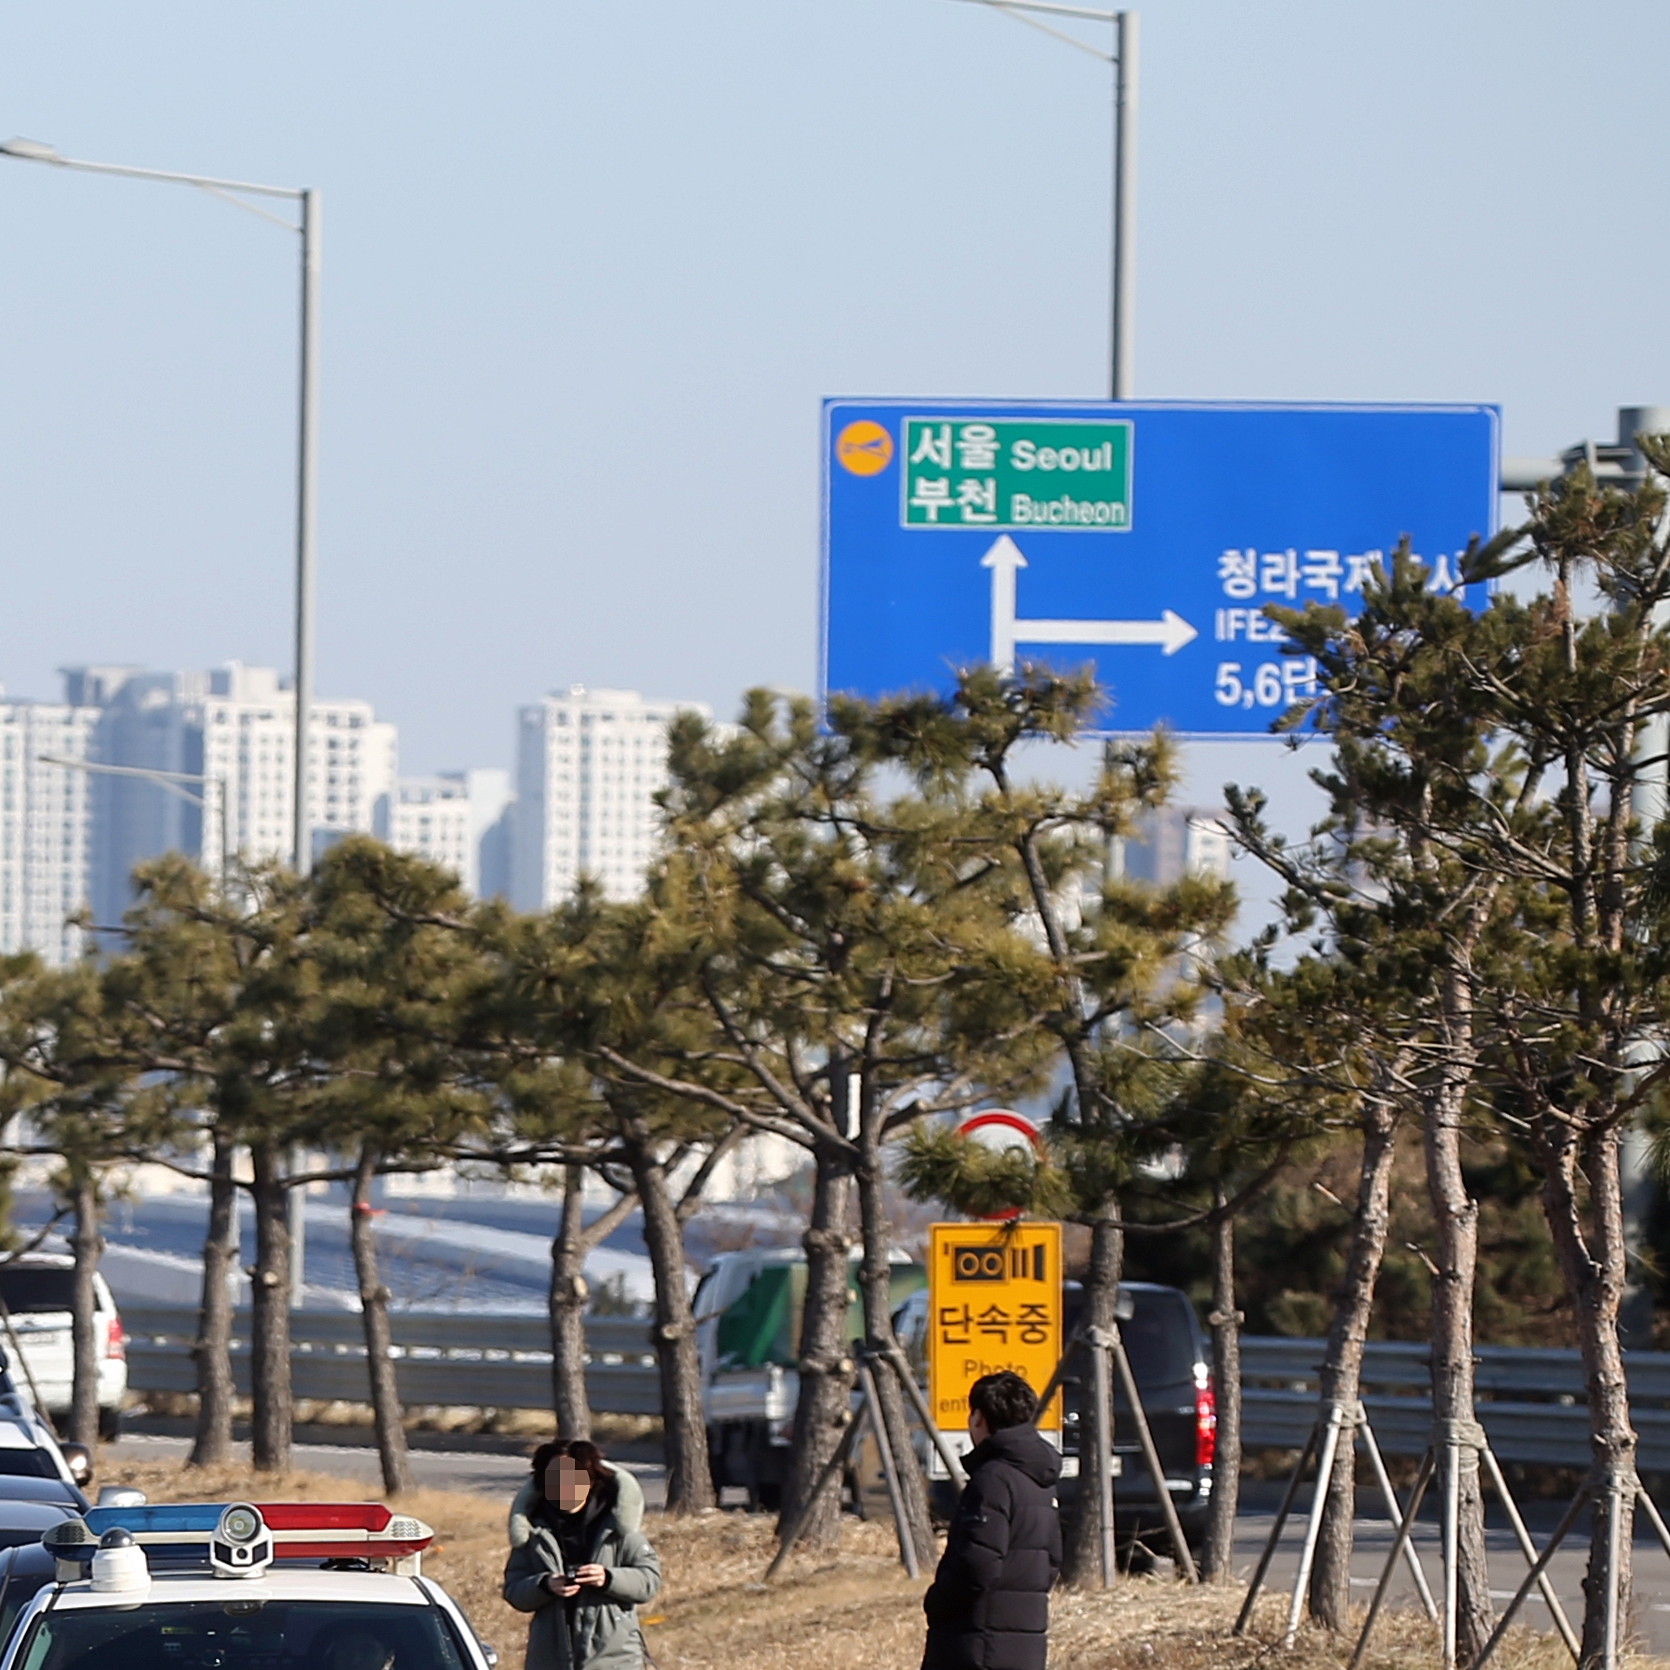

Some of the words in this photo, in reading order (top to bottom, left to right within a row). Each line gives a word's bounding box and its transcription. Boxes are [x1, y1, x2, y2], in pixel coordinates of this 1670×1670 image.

[910, 424, 1001, 470] 서울
[1010, 440, 1113, 471] Seoul
[910, 477, 998, 522] 부천
[1011, 494, 1126, 523] Bucheon
[1215, 657, 1332, 709] 5,6단
[940, 1303, 1051, 1345] 단속중
